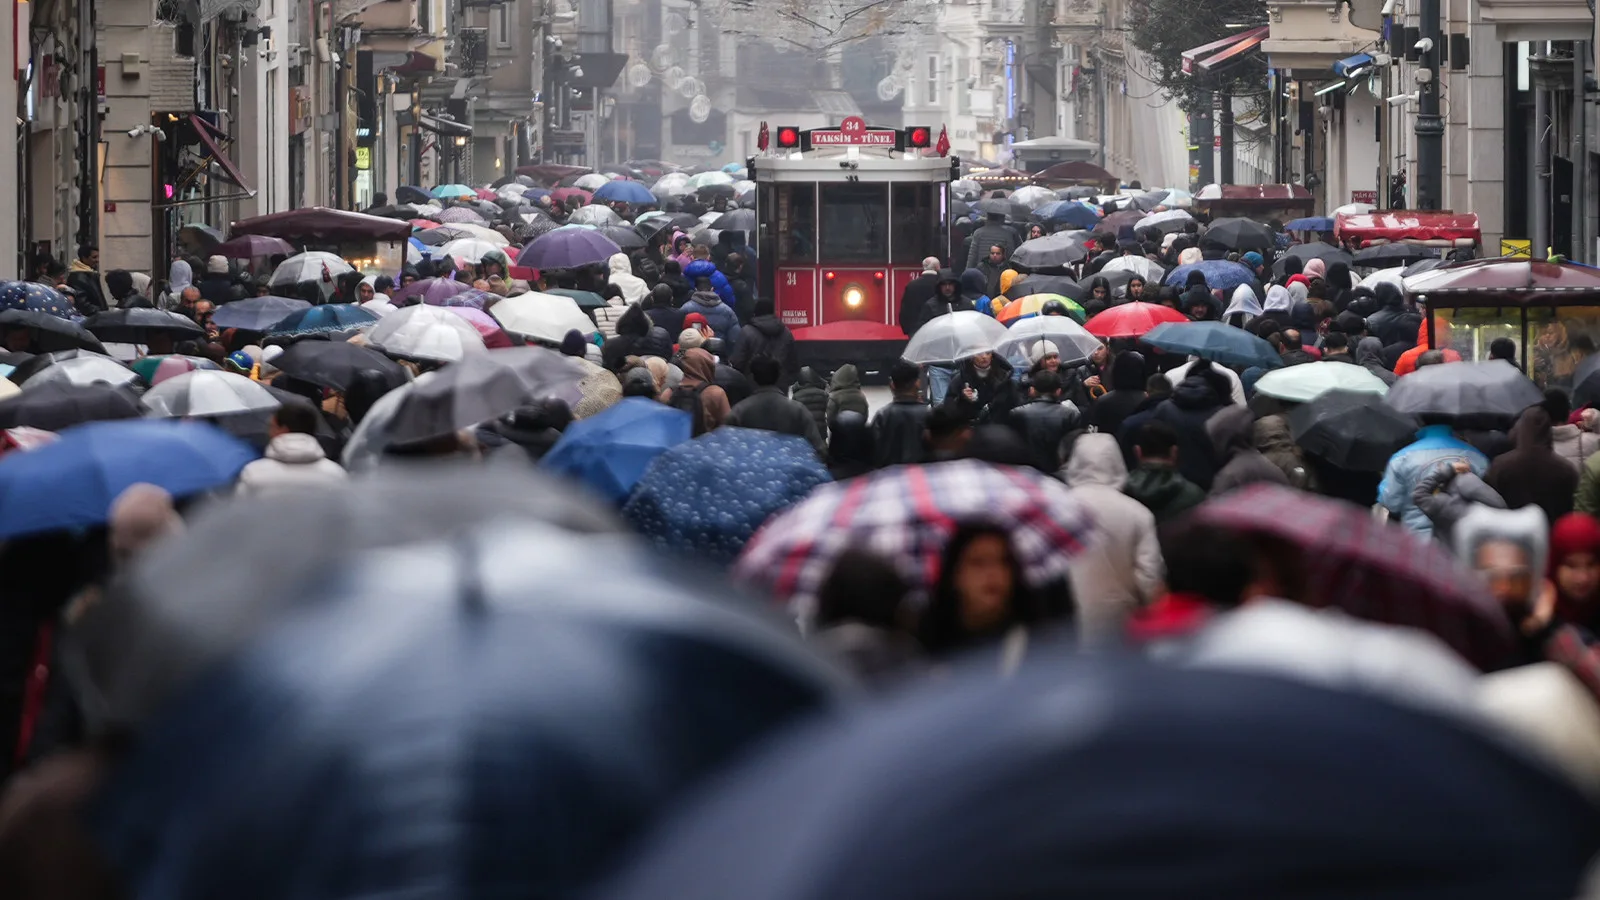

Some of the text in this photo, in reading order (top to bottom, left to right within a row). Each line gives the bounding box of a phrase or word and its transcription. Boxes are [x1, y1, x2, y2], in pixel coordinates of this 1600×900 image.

[846, 121, 859, 130] 34
[815, 132, 851, 143] TAKSİM
[861, 133, 892, 143] TÜNEL
[787, 272, 797, 285] 34
